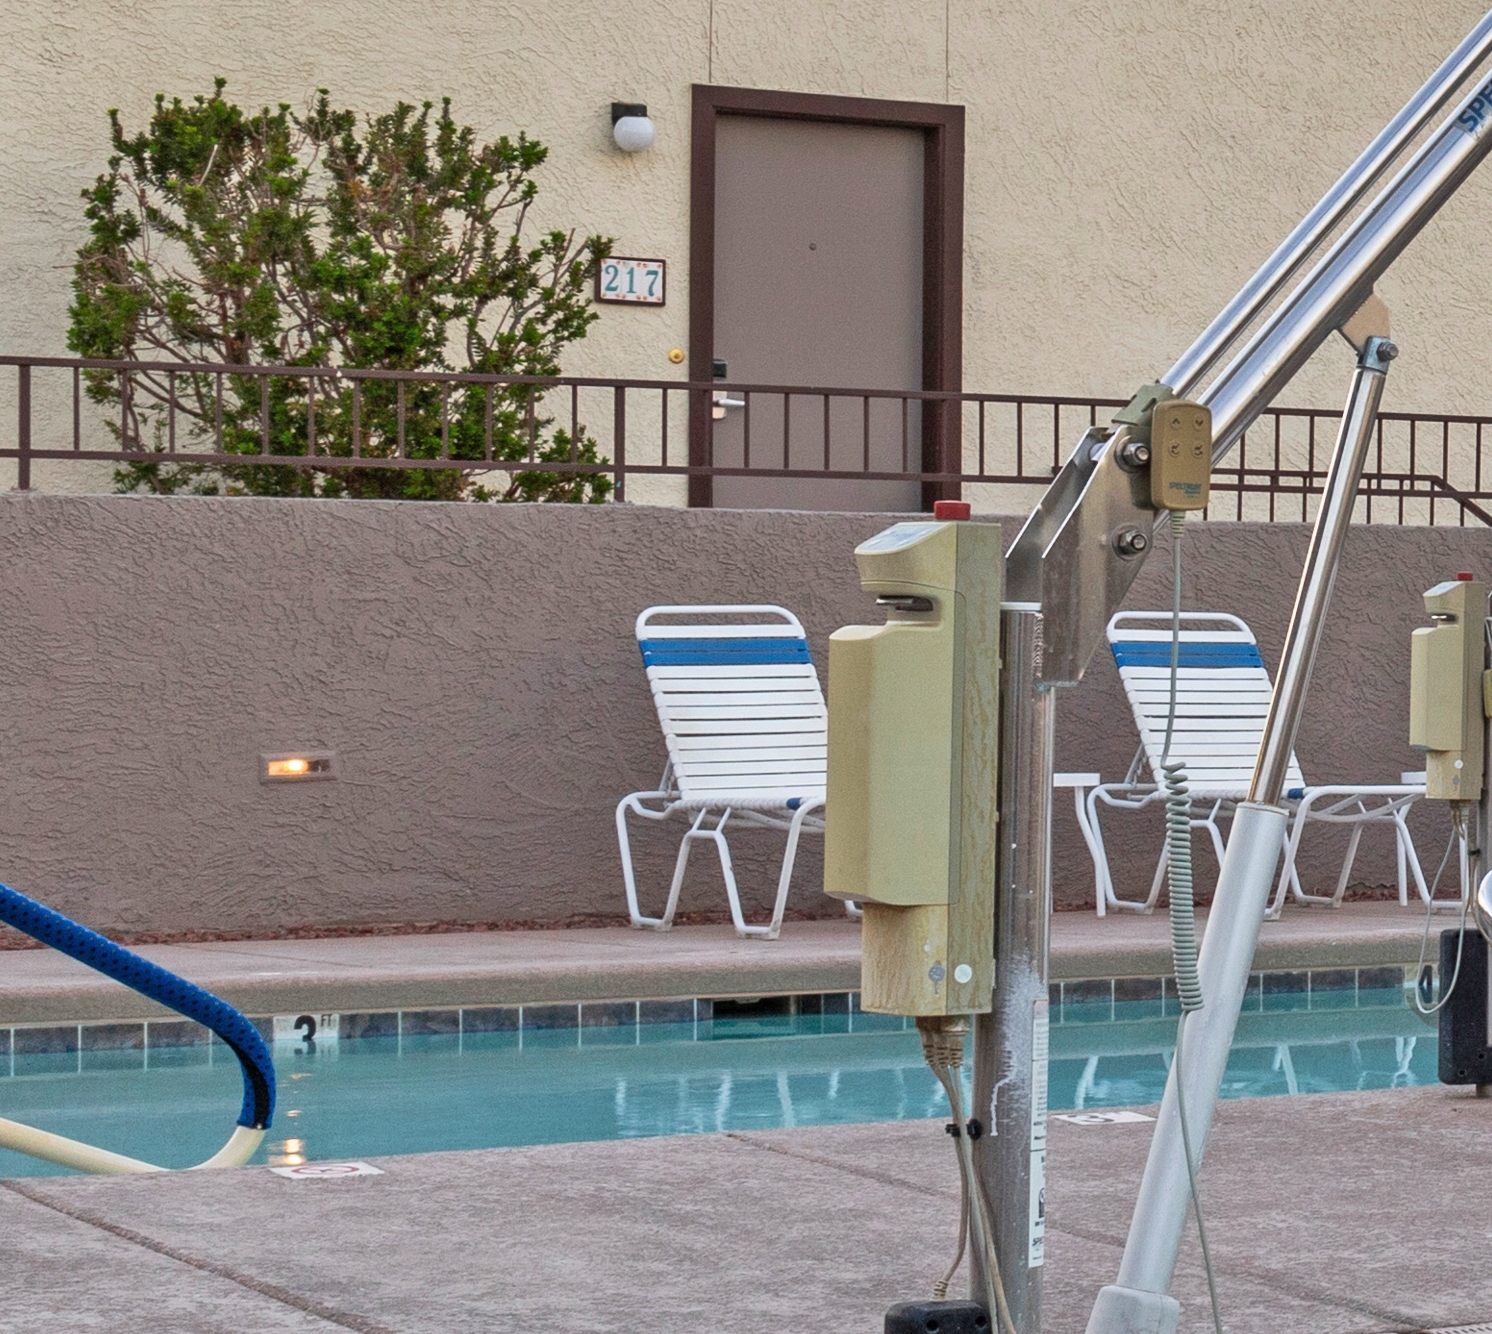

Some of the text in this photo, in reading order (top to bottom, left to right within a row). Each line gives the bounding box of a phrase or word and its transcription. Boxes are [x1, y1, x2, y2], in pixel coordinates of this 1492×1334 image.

[604, 264, 660, 297] 217
[294, 1014, 332, 1053] 3 FT
